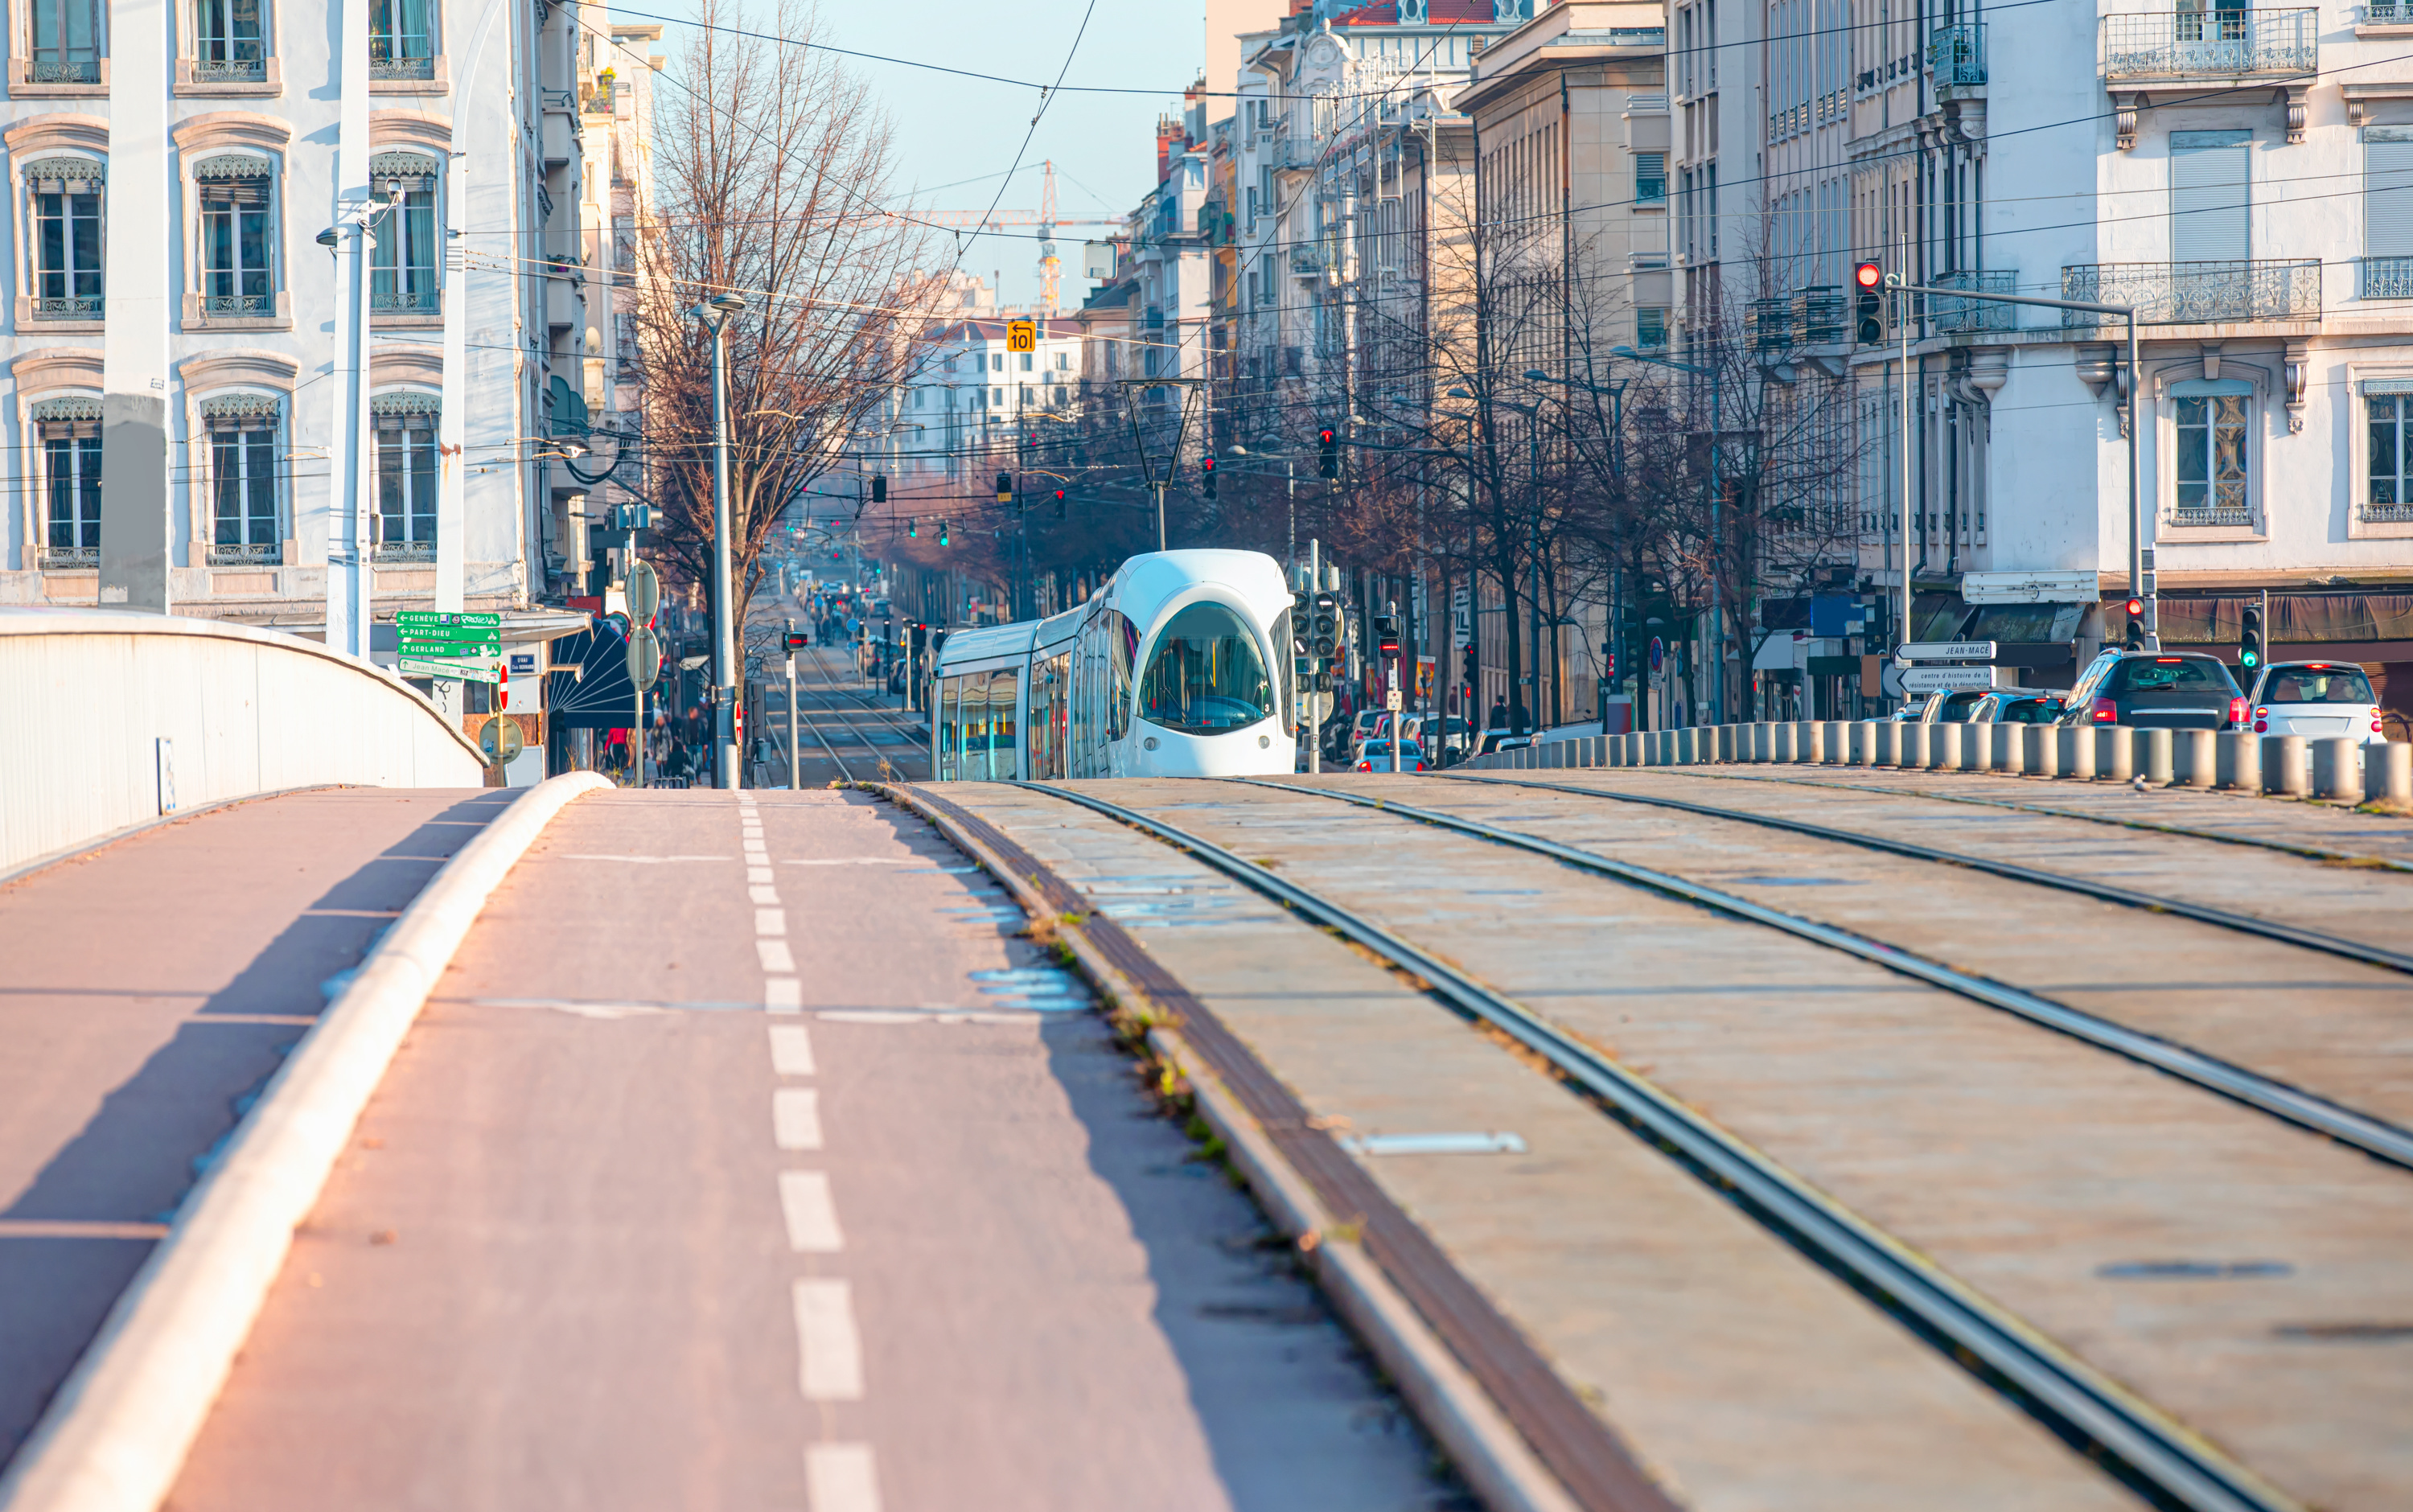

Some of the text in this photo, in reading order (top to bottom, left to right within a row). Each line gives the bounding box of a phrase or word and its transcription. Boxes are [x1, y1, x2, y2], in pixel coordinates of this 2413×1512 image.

[1011, 335, 1028, 349] 10
[409, 614, 438, 622] GENÈVE
[409, 628, 450, 637] PART-DIEU
[410, 645, 445, 653] GERLAND
[1946, 645, 1989, 655] JEAN-MACÉ
[412, 663, 430, 672] Jean
[431, 665, 450, 674] Macé
[1264, 704, 1270, 713] 3
